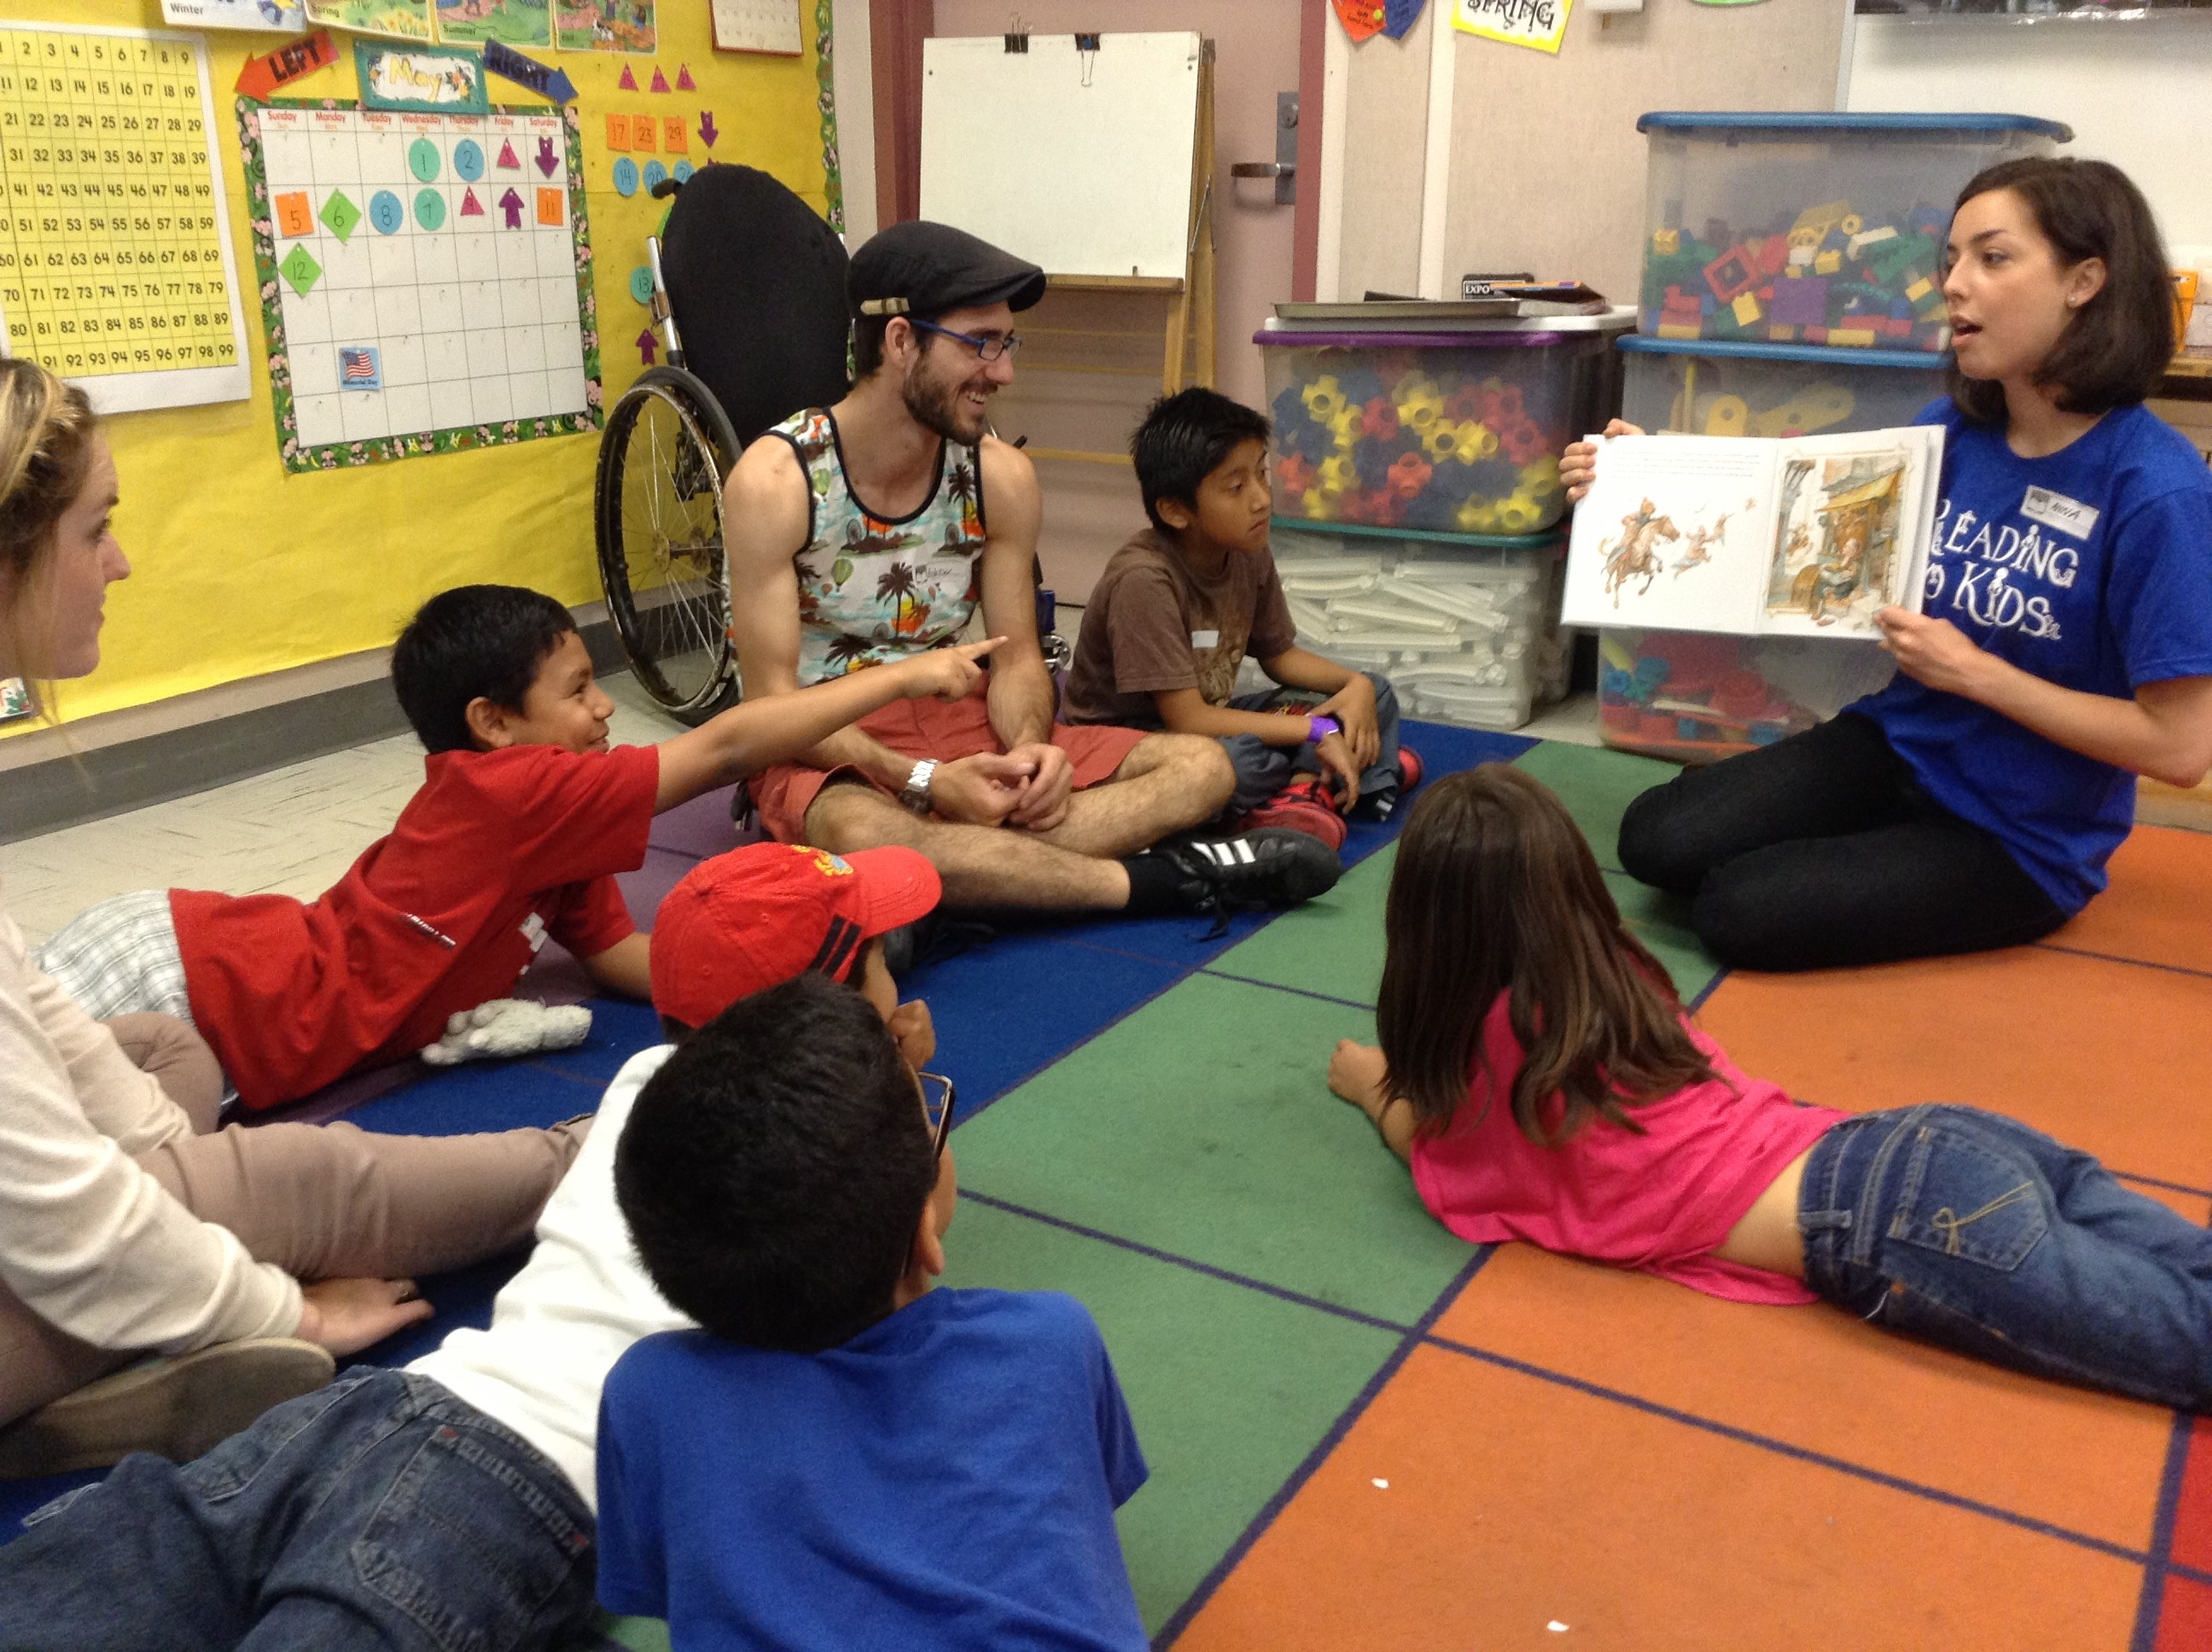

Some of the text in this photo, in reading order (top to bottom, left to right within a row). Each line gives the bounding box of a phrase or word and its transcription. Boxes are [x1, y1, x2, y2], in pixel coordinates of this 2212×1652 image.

[171, 3, 203, 15] Winter
[22, 41, 32, 55] 2
[47, 43, 56, 57] 3
[70, 44, 79, 58] 4
[94, 45, 103, 60] 5
[118, 48, 127, 61] 6
[139, 49, 148, 62] 7
[160, 50, 169, 64] 8
[181, 51, 189, 65] 9
[268, 39, 321, 83] LEFT
[1, 76, 196, 99] 11 12 13 14 15 16 17 18 19
[389, 57, 442, 102] May
[4, 112, 202, 132] 21 22 23 24 25 26 27 28 29
[267, 110, 297, 123] Sunday
[315, 112, 346, 124] Monday
[363, 113, 393, 125] Tuesday
[401, 114, 442, 125] Wednesday
[494, 116, 514, 127] Friday
[530, 117, 557, 128] Saturday
[613, 122, 625, 143] 17
[9, 148, 207, 166] 31 32 33 34 35 36 37 38 39
[463, 149, 474, 170] 2
[14, 183, 28, 196] 41
[36, 183, 54, 197] 42
[61, 183, 78, 197] 43
[84, 183, 101, 196] 44
[107, 183, 124, 197] 45
[130, 183, 147, 197] 46
[152, 183, 167, 197] 47
[174, 184, 190, 197] 48
[195, 184, 211, 197] 49
[19, 218, 33, 232] 51
[43, 218, 59, 232] 52
[66, 218, 83, 231] 53
[89, 218, 105, 231] 54
[112, 218, 128, 231] 55
[134, 217, 151, 231] 56
[156, 217, 172, 230] 57
[178, 217, 194, 230] 58
[200, 217, 214, 230] 59
[291, 210, 302, 230] 5
[334, 204, 345, 228] 6
[381, 204, 393, 227] 8
[23, 253, 38, 267] 61
[47, 253, 65, 266] 62
[70, 253, 88, 266] 63
[93, 252, 110, 265] 64
[116, 251, 133, 265] 65
[138, 251, 155, 265] 66
[160, 250, 176, 264] 67
[182, 249, 198, 263] 68
[203, 249, 219, 262] 69
[292, 261, 307, 282] 12
[3, 281, 224, 302] 70 71 72 73 74 75 76 77 78 79
[1465, 284, 1490, 294] EXPO
[9, 311, 229, 337] 80 81 82 83 84 85 86 87 88 89
[43, 355, 58, 368] 91
[65, 354, 83, 367] 92
[88, 352, 107, 365] 93
[111, 351, 128, 364] 94
[134, 349, 151, 363] 95
[155, 348, 173, 361] 96
[177, 346, 193, 360] 97
[198, 345, 214, 358] 98
[218, 343, 234, 356] 99
